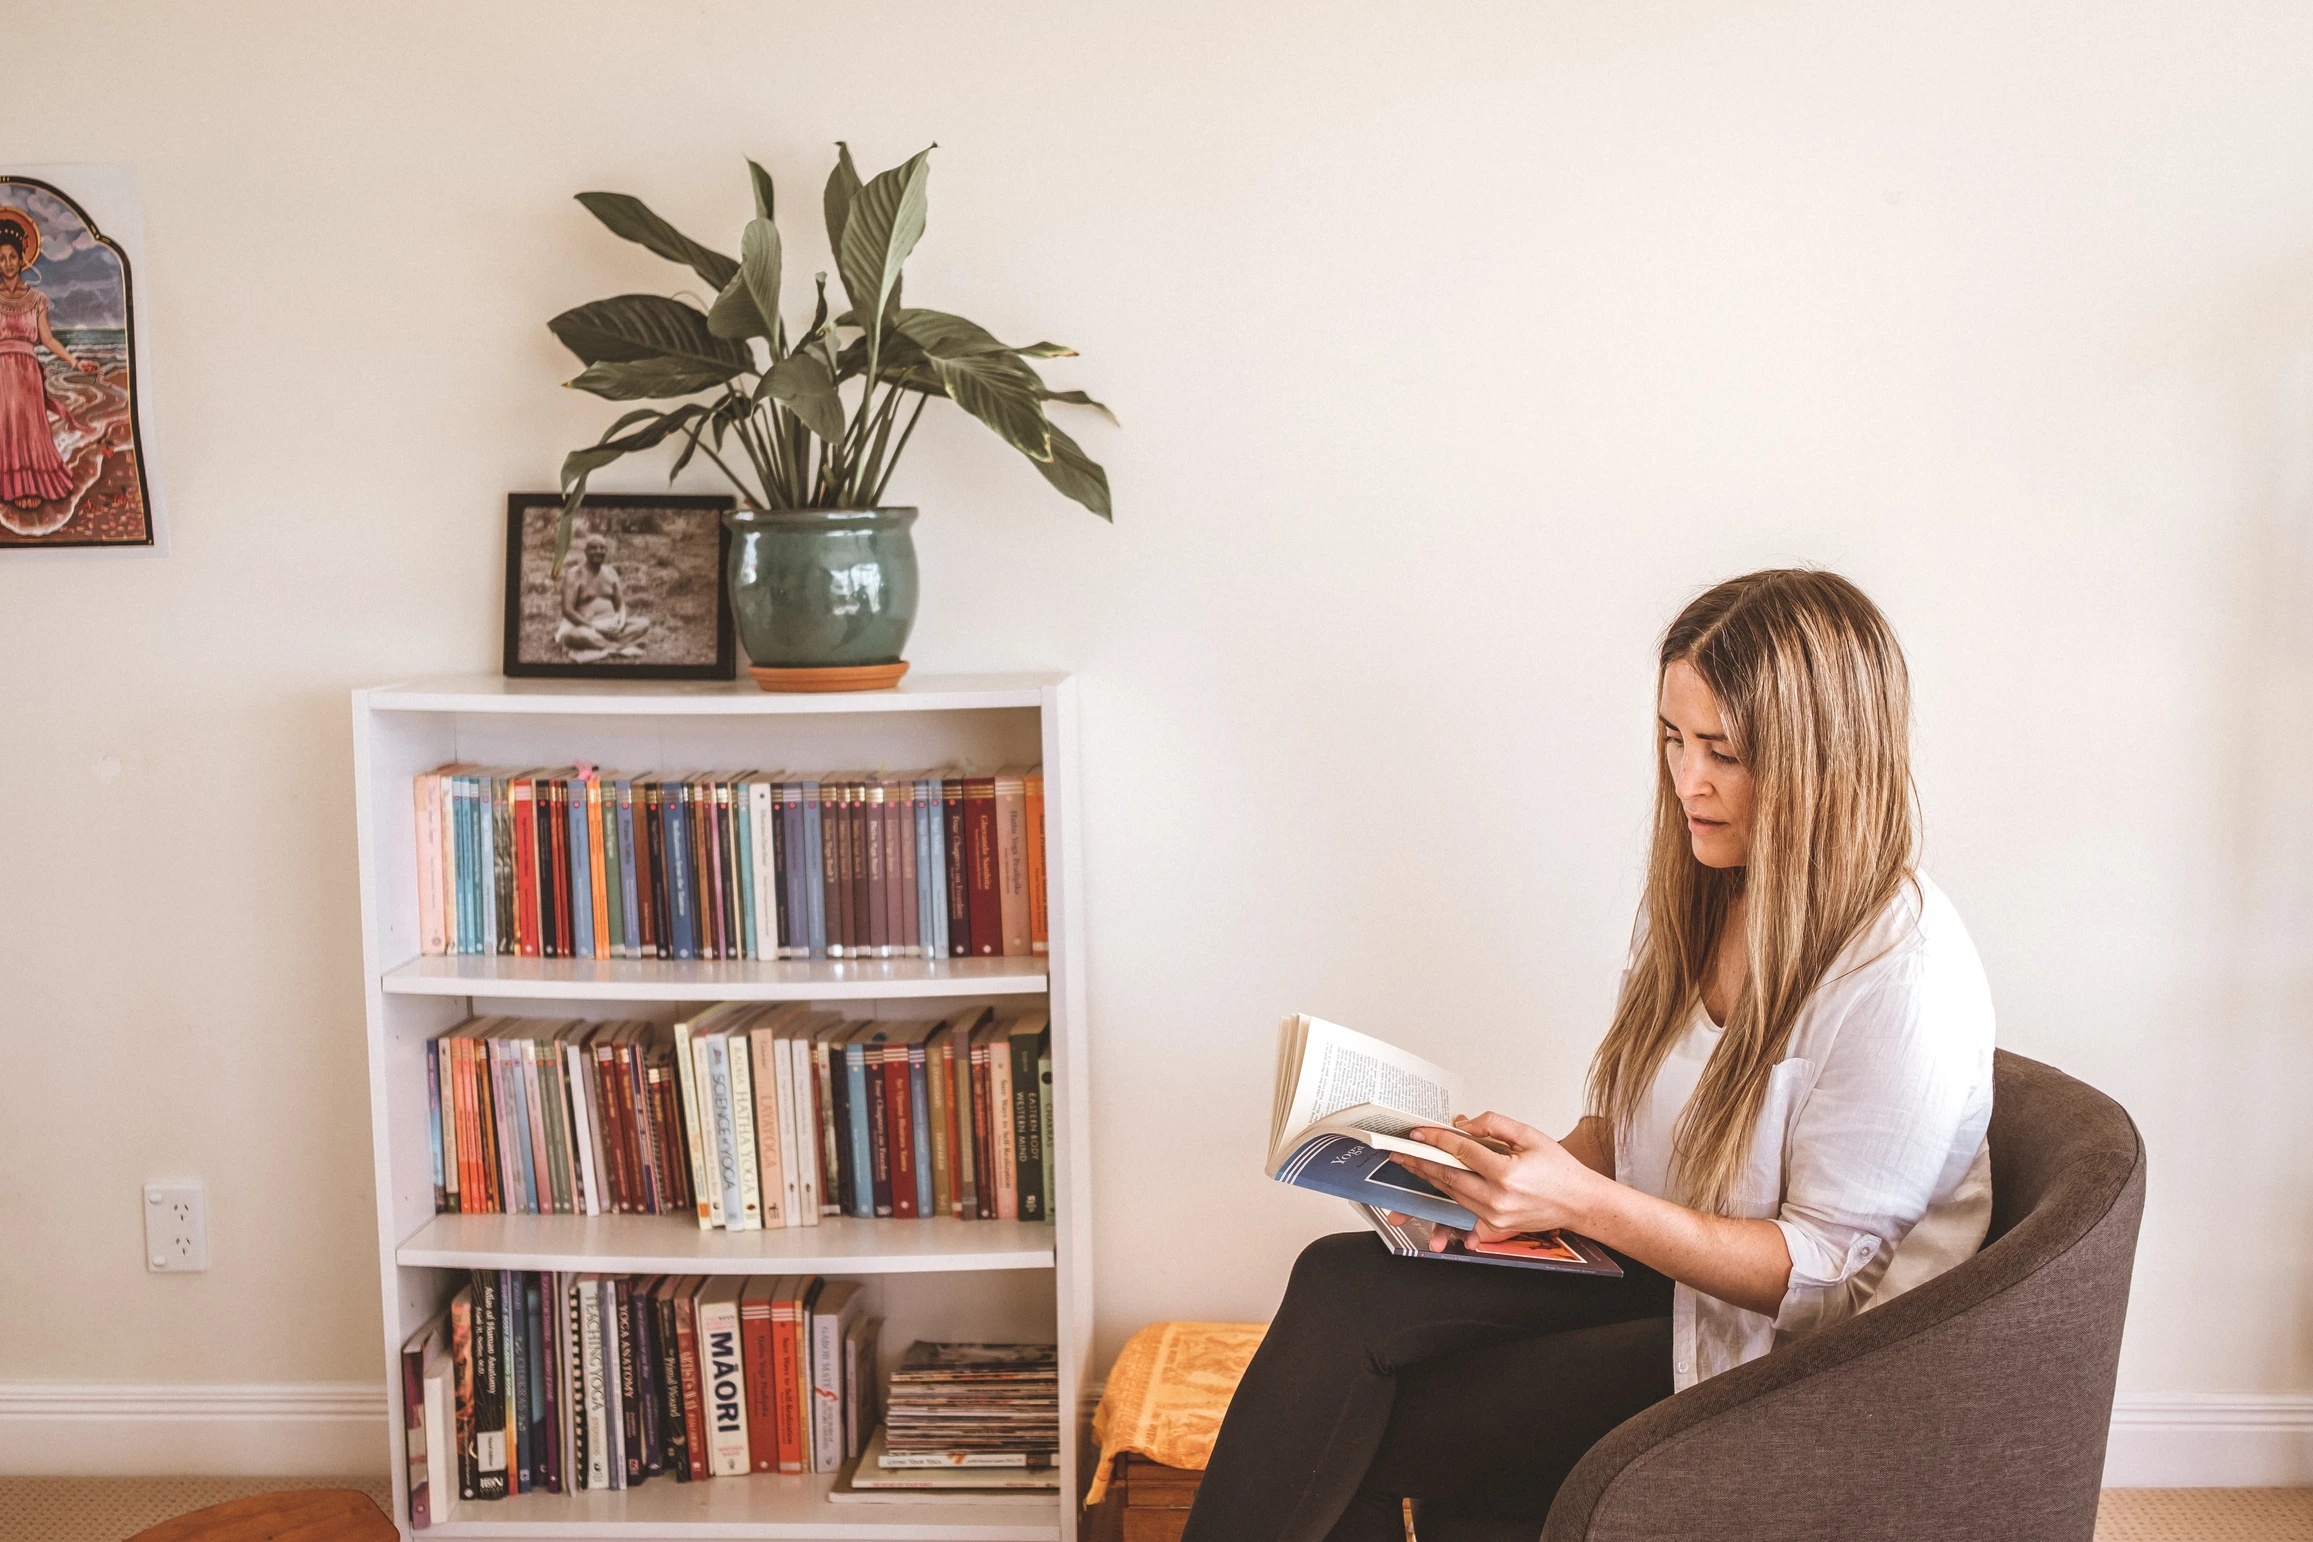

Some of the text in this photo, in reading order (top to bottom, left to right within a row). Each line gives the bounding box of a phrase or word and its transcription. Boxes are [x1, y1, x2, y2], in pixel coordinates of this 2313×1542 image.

[952, 816, 960, 834] Four
[981, 815, 990, 855] Gheranda
[952, 836, 962, 871] Chapters
[1010, 811, 1021, 895] Hatha Yoga Pradipika
[955, 873, 960, 882] on
[956, 886, 964, 919] Freedom
[713, 1073, 731, 1135] SCIENCE
[736, 1091, 752, 1147] HATHA
[876, 1099, 885, 1133] Chapters
[1001, 1099, 1009, 1118] Ways
[1003, 1120, 1009, 1128] to
[760, 1094, 777, 1169] LAYAYOGA
[1016, 1091, 1027, 1162] WESTERN MIND
[1028, 1092, 1039, 1161] EASTERN BODY
[721, 1147, 735, 1191] YOGA
[740, 1150, 755, 1194] YOGA
[880, 1148, 888, 1180] Freedom
[1003, 1131, 1011, 1188] Self-Realization
[1330, 1145, 1365, 1165] Yoga
[485, 1286, 496, 1394] Atlas of Human Anatomy
[586, 1293, 602, 1366] TEACHING
[619, 1304, 630, 1338] YOGA
[516, 1357, 527, 1411] CHAKRAS
[621, 1340, 634, 1398] ANATOMY
[665, 1357, 677, 1385] Primal
[759, 1361, 768, 1378] Yoga
[785, 1378, 791, 1386] to
[590, 1368, 604, 1411] YOGA
[667, 1385, 681, 1417] Wound
